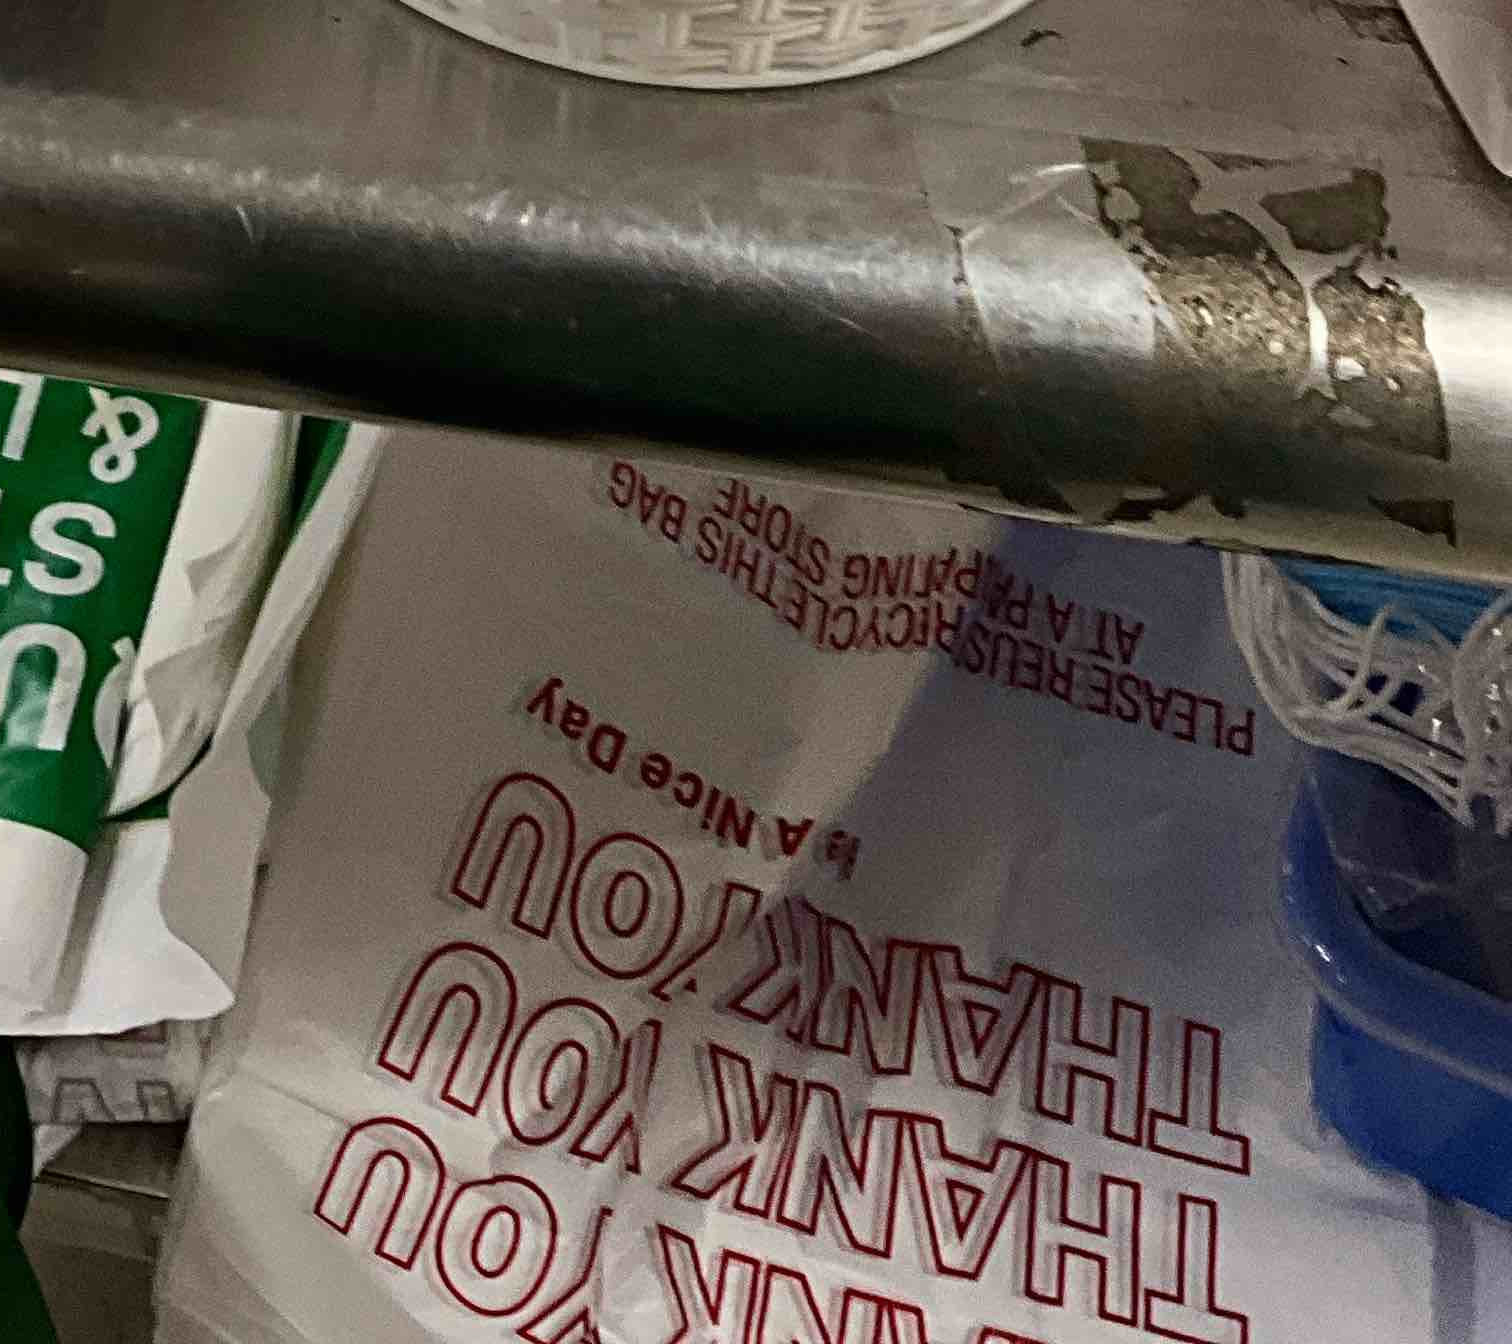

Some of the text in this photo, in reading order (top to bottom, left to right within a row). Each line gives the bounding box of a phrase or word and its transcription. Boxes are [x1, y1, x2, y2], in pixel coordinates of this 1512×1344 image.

[80, 385, 161, 484] &
[607, 462, 687, 543] BAG
[712, 477, 831, 587] STORE
[695, 516, 778, 610] THIS
[1046, 593, 1076, 643] A
[1088, 611, 1145, 665] AT
[526, 677, 629, 775] Day
[1085, 662, 1257, 757] PLEASE
[638, 751, 757, 849] Nice
[776, 816, 816, 857] A
[451, 771, 1252, 1179] THANK YOU
[378, 940, 663, 1175] YOU
[669, 1042, 1250, 1344] THANK
